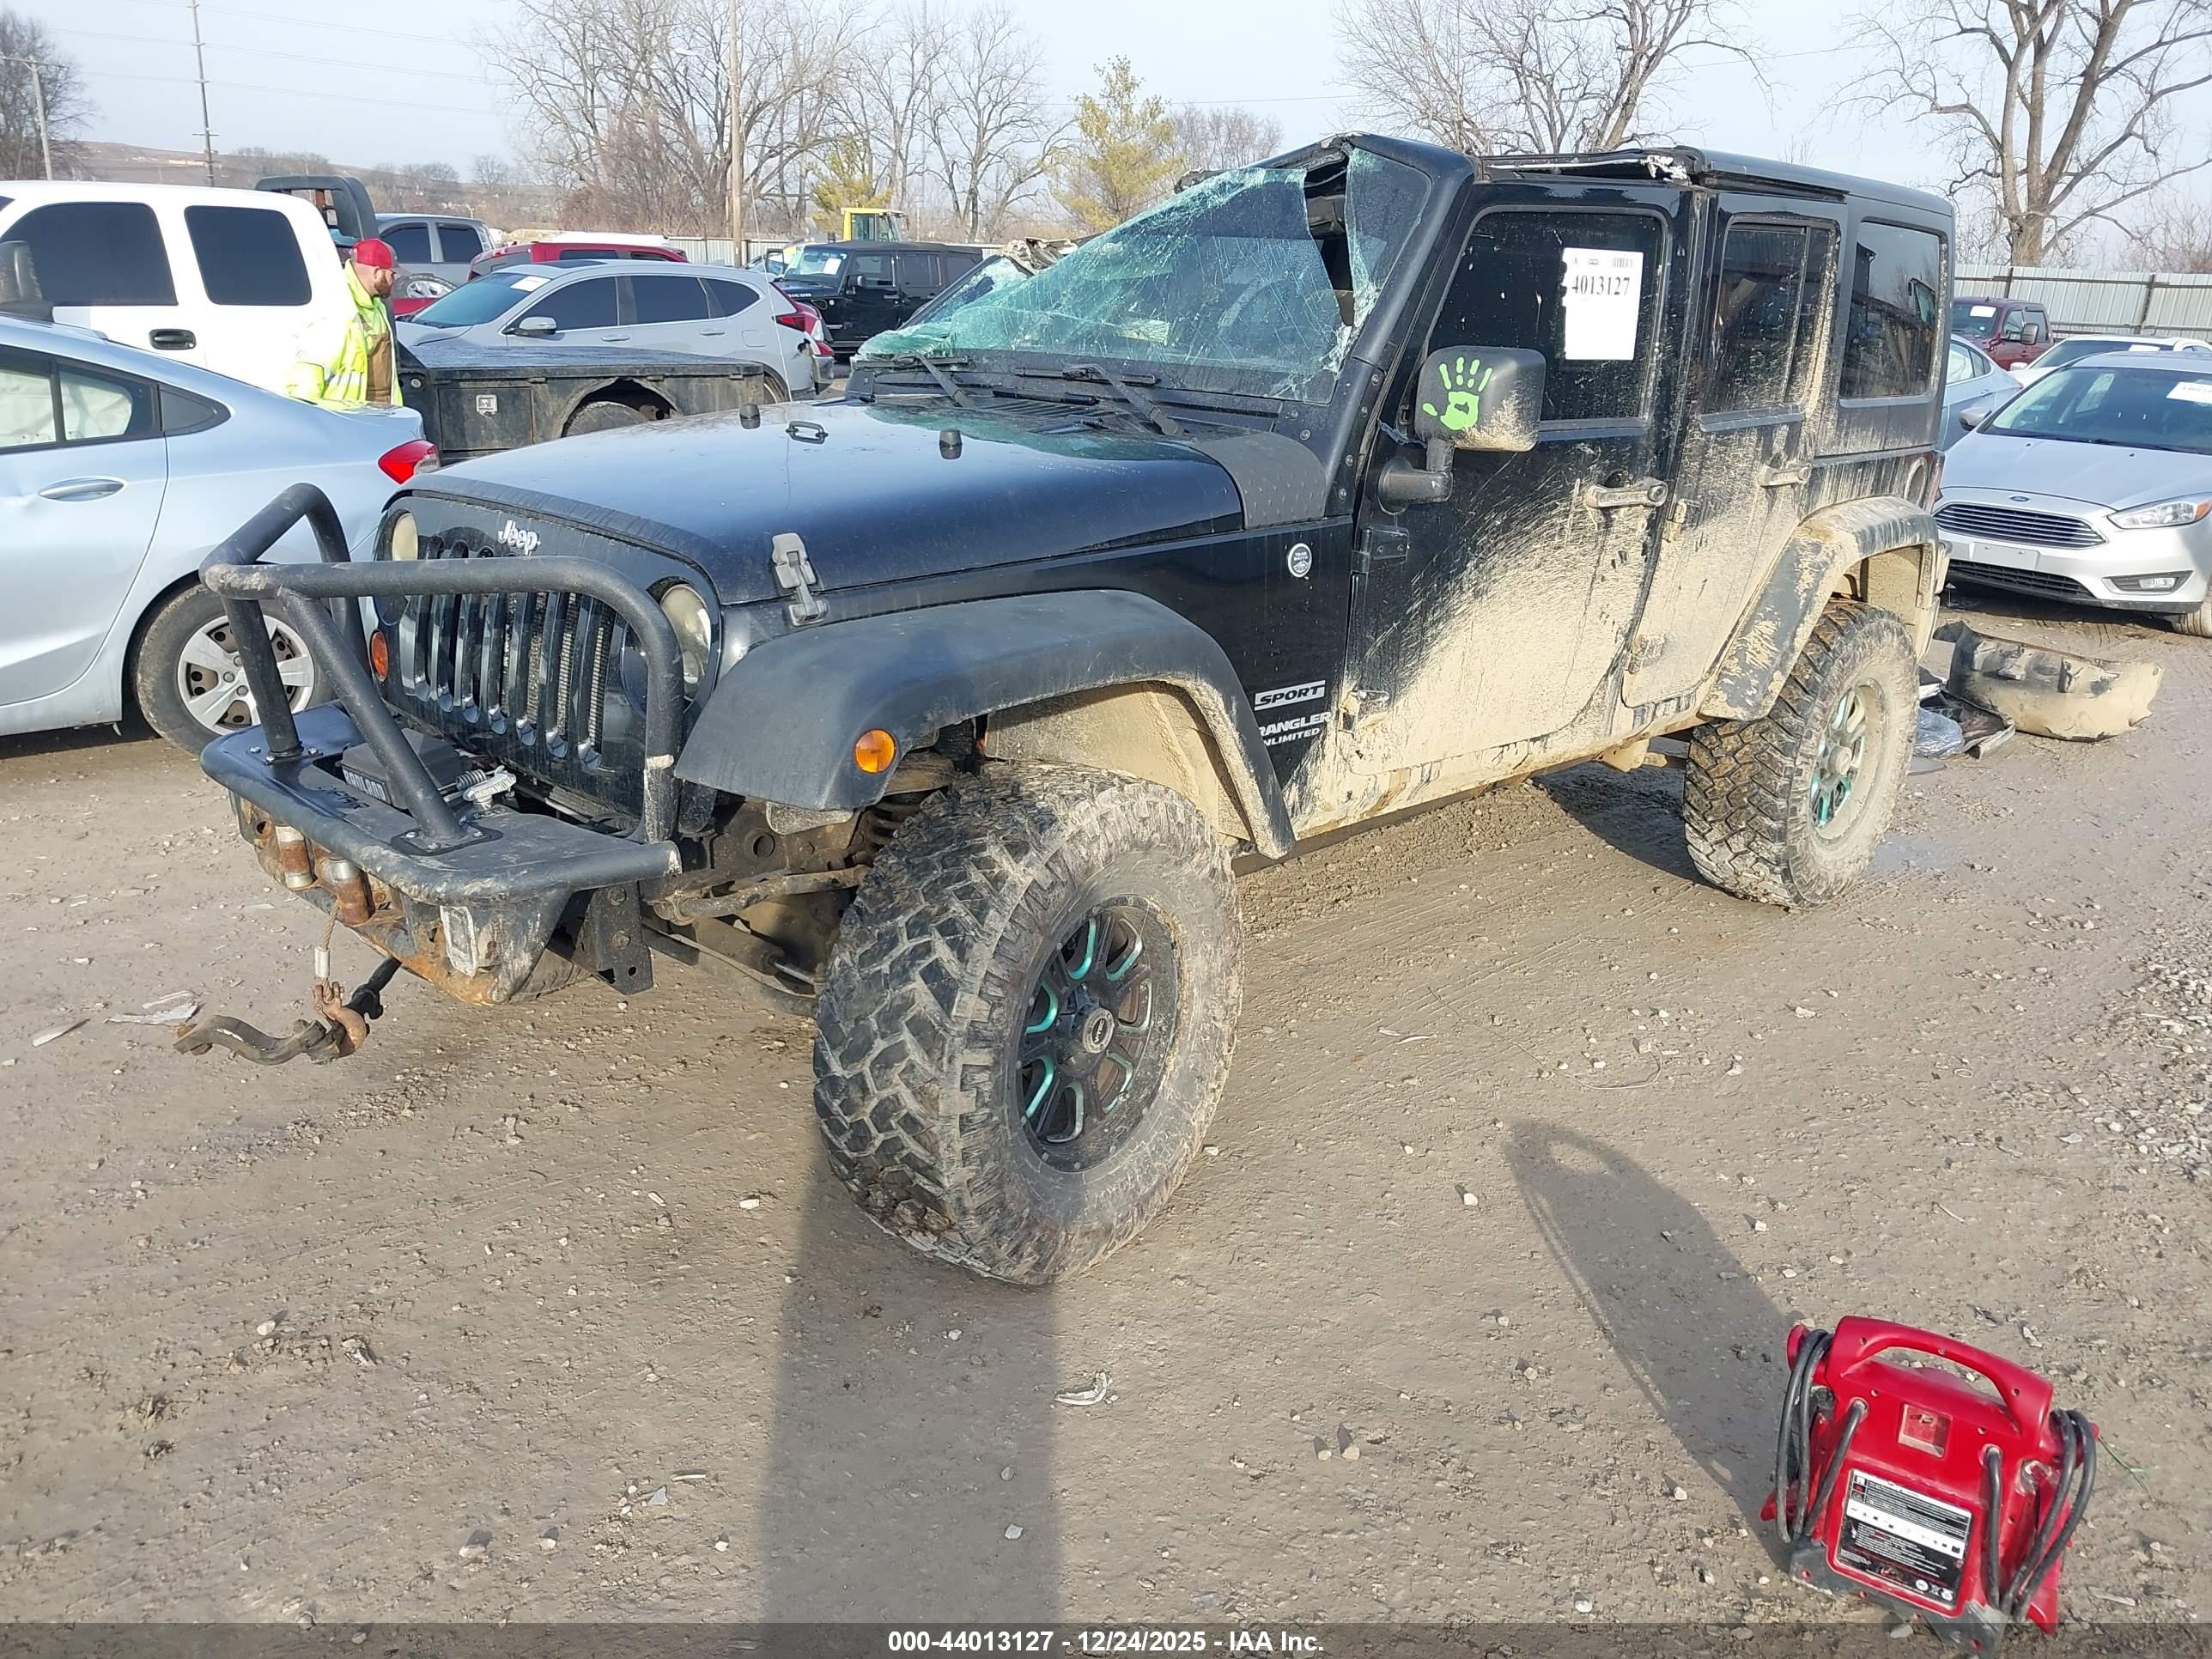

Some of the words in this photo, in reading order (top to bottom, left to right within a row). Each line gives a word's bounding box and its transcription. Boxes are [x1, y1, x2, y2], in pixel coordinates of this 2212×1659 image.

[497, 520, 538, 557] Jeep
[1259, 686, 1320, 705] SPORT
[1258, 711, 1332, 737] RANGLER
[1263, 727, 1321, 747] NLIMITED
